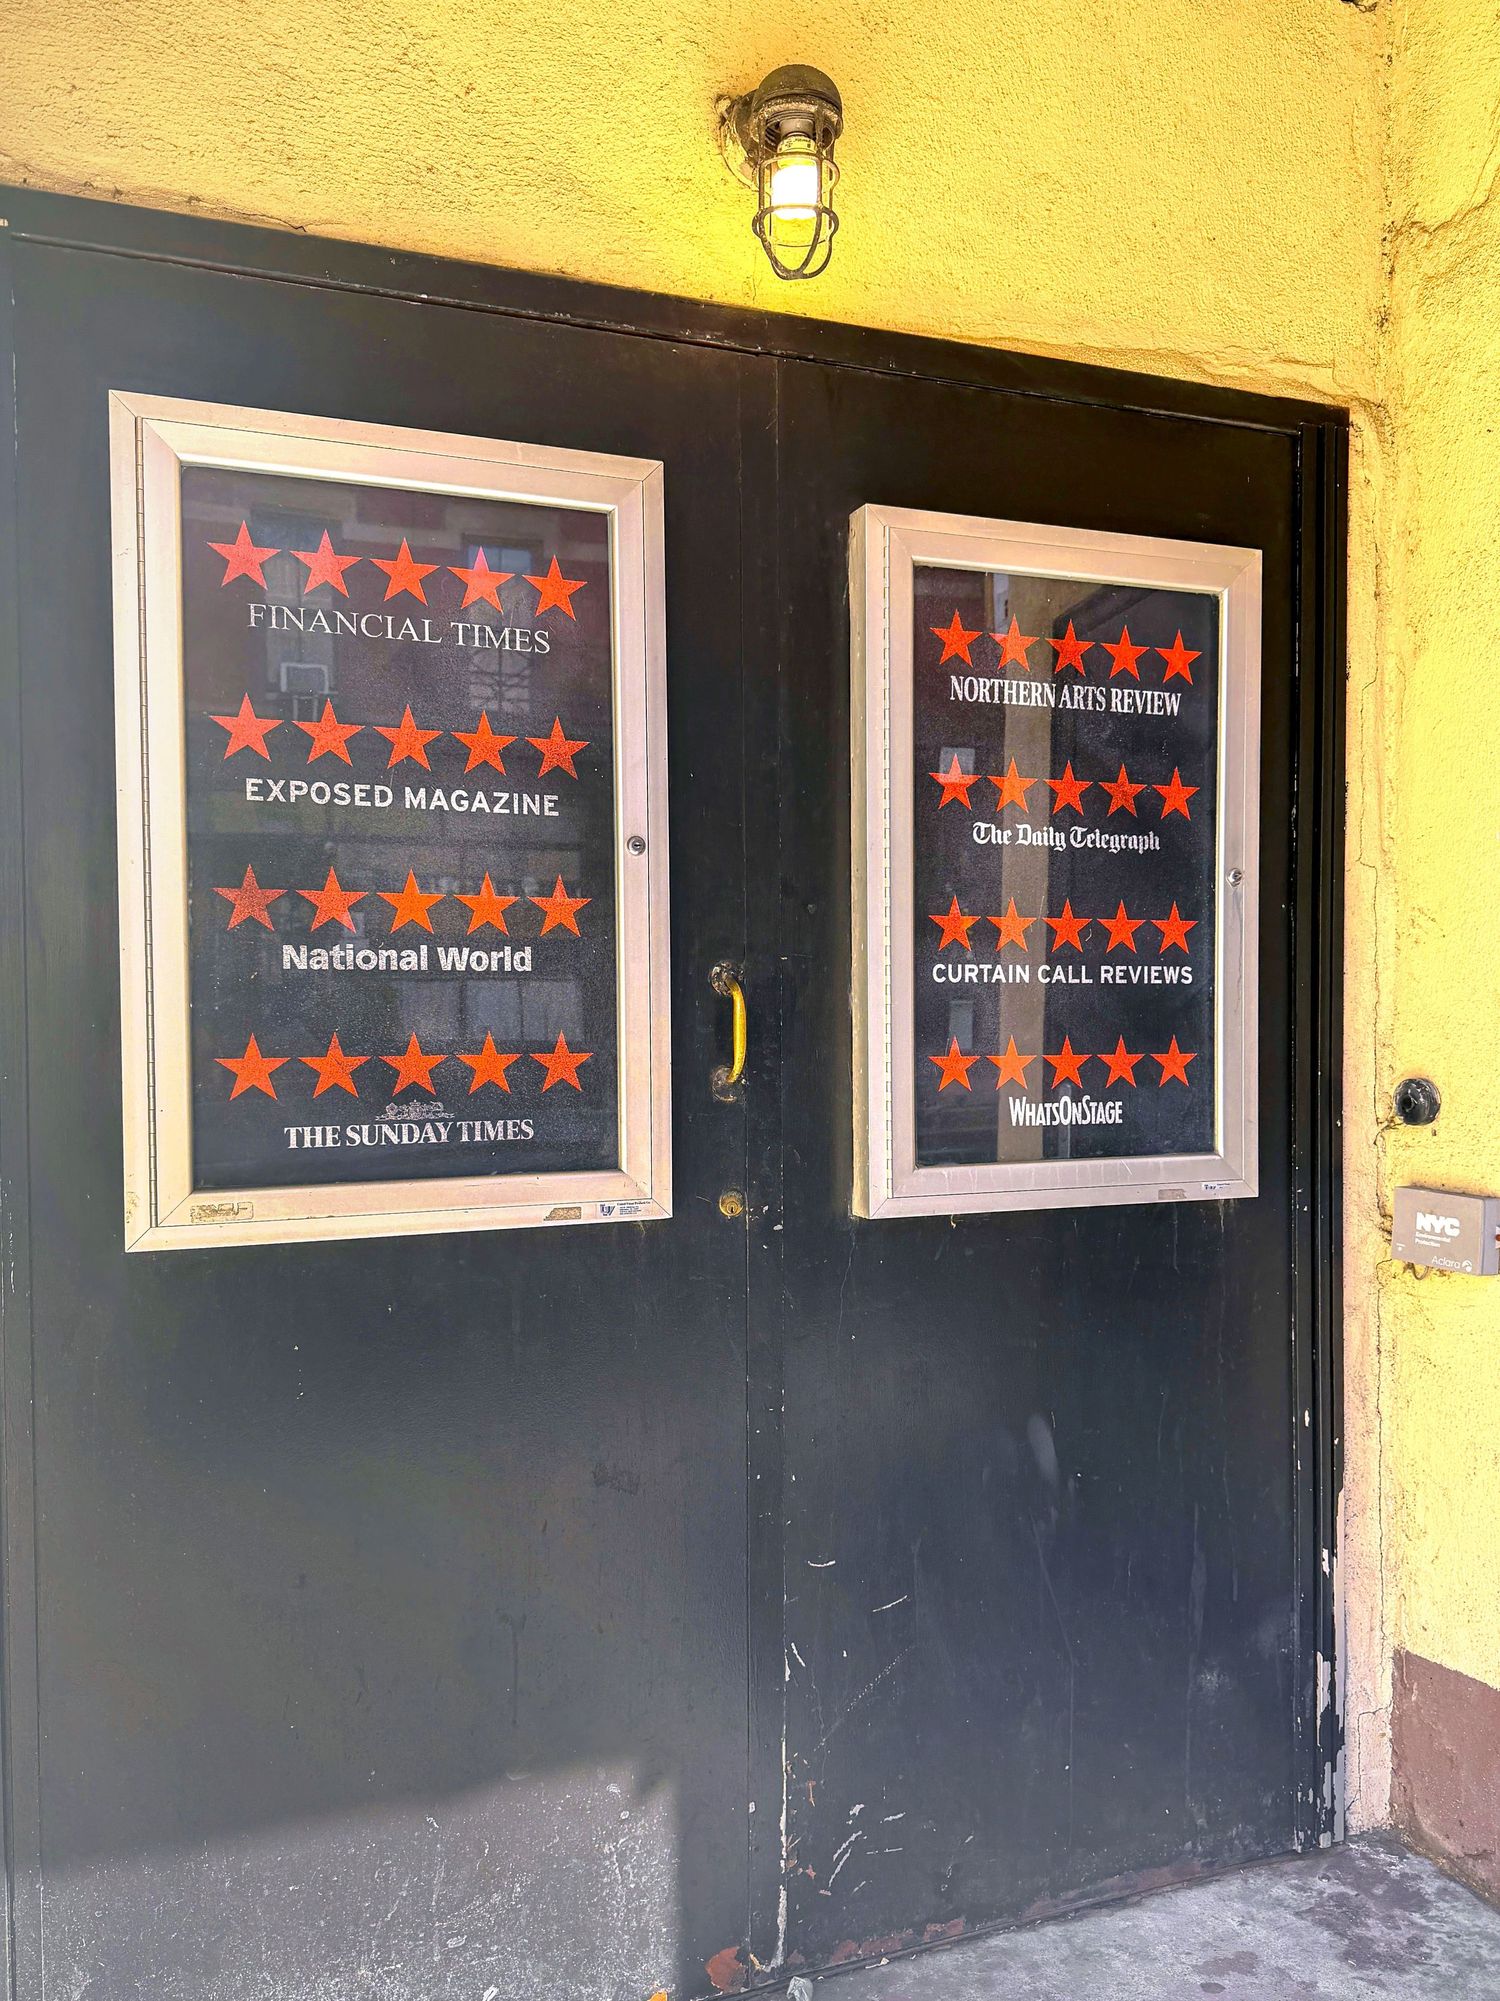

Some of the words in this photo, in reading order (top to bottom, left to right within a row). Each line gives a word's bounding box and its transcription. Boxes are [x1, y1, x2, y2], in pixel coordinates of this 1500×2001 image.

[247, 603, 442, 644] FINANCIAL
[450, 621, 551, 655] TIMES
[949, 674, 1056, 707] NORTHERN
[1058, 683, 1107, 711] ARTS
[1109, 686, 1182, 718] REVIEW
[245, 777, 394, 808] EXPOSED
[404, 786, 560, 818] MAGAZINE
[972, 821, 1012, 847] The
[1014, 823, 1067, 852] Daily
[1069, 826, 1161, 854] Telegraph
[282, 943, 429, 972] National
[436, 945, 532, 972] World
[932, 963, 1030, 984] CURTAIN
[1037, 964, 1093, 984] CALL
[1100, 965, 1193, 985] REVIEWS
[284, 1125, 342, 1149] THE
[345, 1121, 454, 1147] SUNDAY
[456, 1118, 535, 1142] TIMES
[1416, 1212, 1460, 1237] NYC
[1431, 1256, 1461, 1269] Aclara
